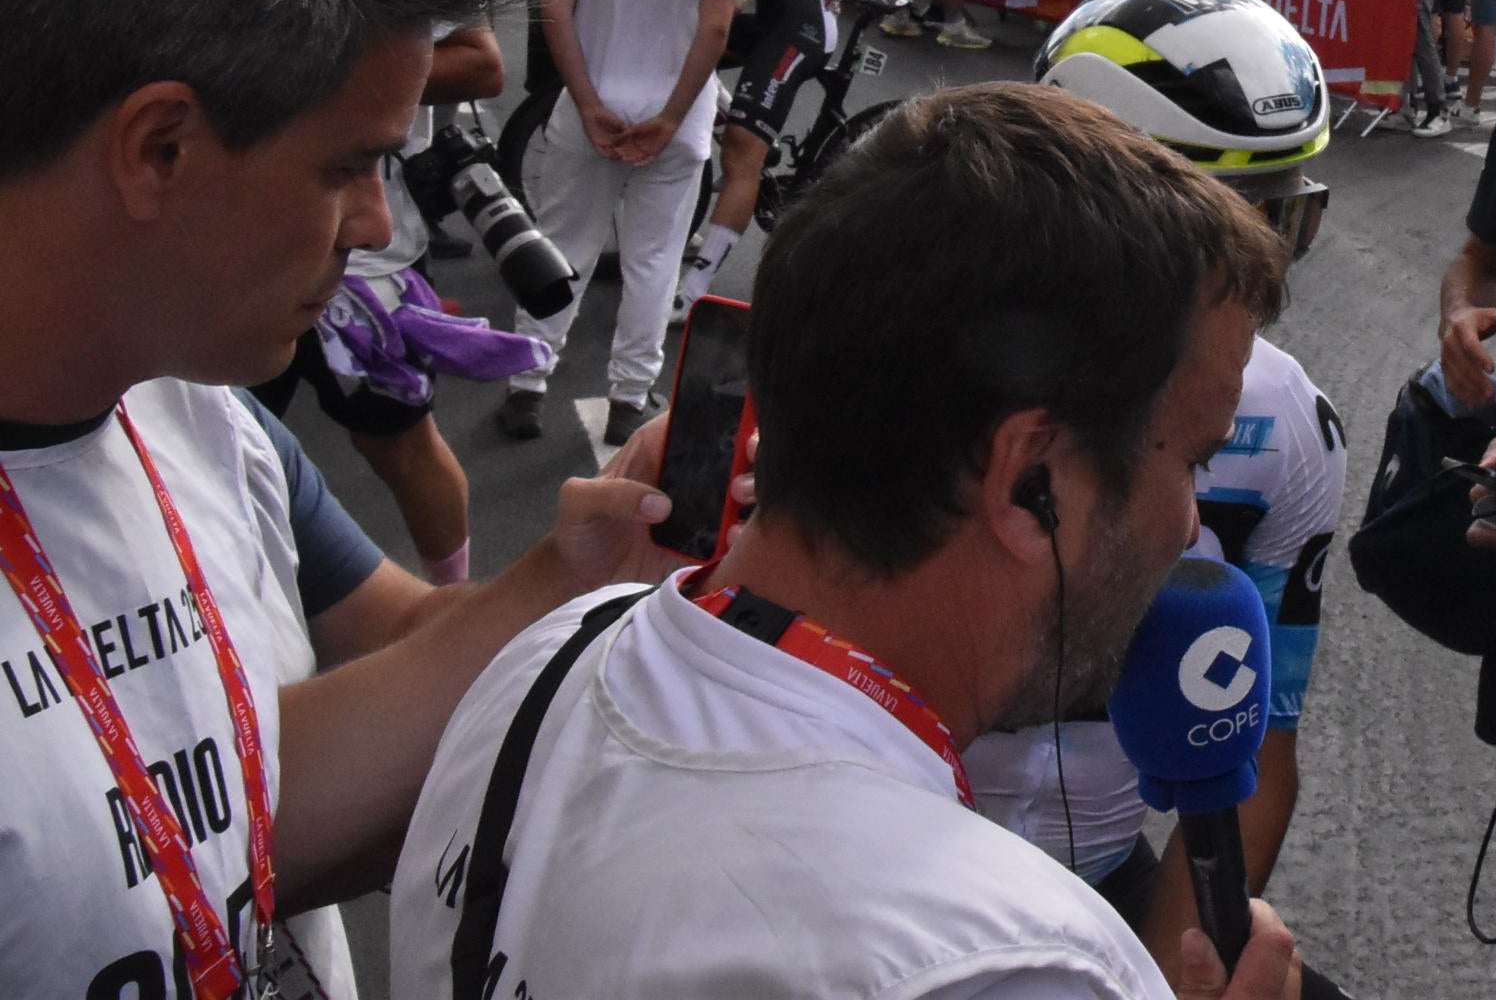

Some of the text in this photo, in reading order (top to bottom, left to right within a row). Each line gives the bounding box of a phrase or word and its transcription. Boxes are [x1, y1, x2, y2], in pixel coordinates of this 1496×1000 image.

[862, 51, 886, 75] 184
[1262, 96, 1301, 112] ABUS
[2, 650, 61, 718] LA
[43, 596, 189, 695] ELTA
[847, 667, 886, 703] VUELTA
[1187, 703, 1260, 747] COPE
[105, 736, 232, 890] RDIO
